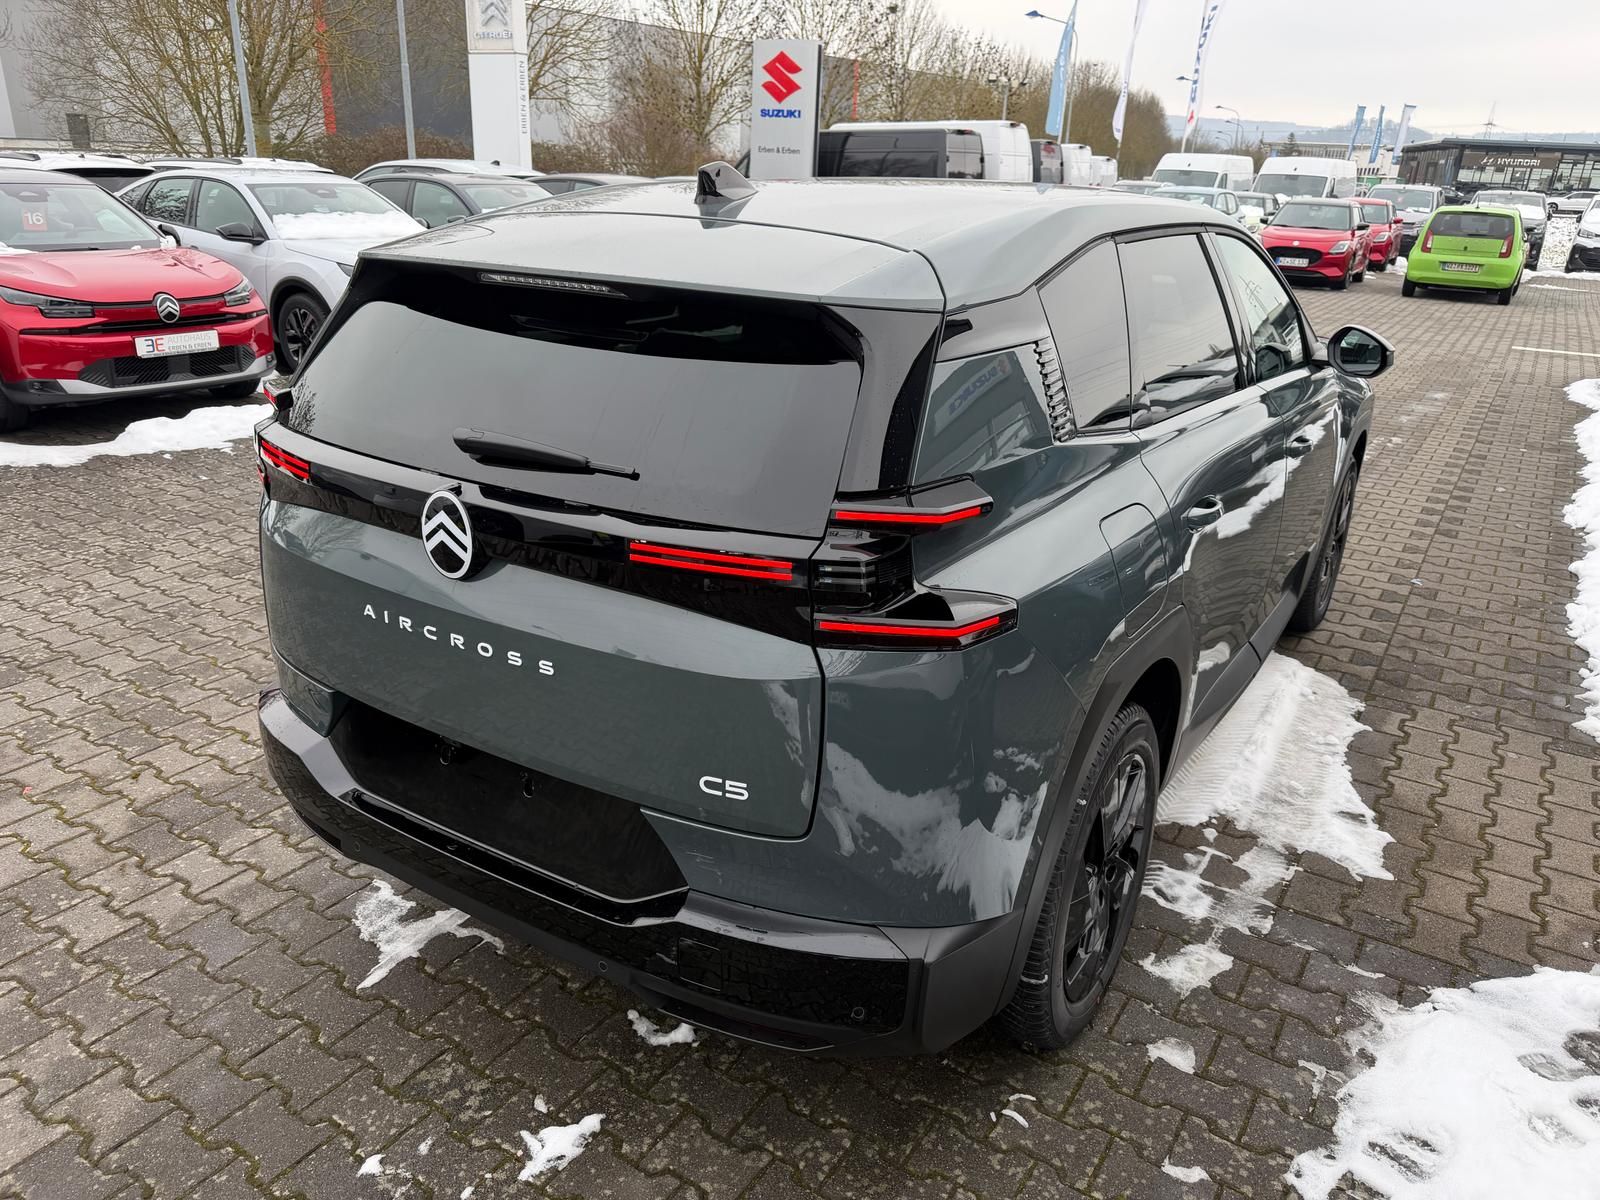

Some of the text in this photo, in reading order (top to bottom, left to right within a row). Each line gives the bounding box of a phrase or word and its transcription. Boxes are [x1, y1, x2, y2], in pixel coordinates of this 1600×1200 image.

[760, 108, 801, 119] SUZUKI
[759, 145, 775, 153] Erben
[1497, 158, 1541, 167] HYUNDAI
[25, 211, 43, 225] 16
[363, 604, 555, 676] AIRCROSS
[699, 775, 749, 801] C5
